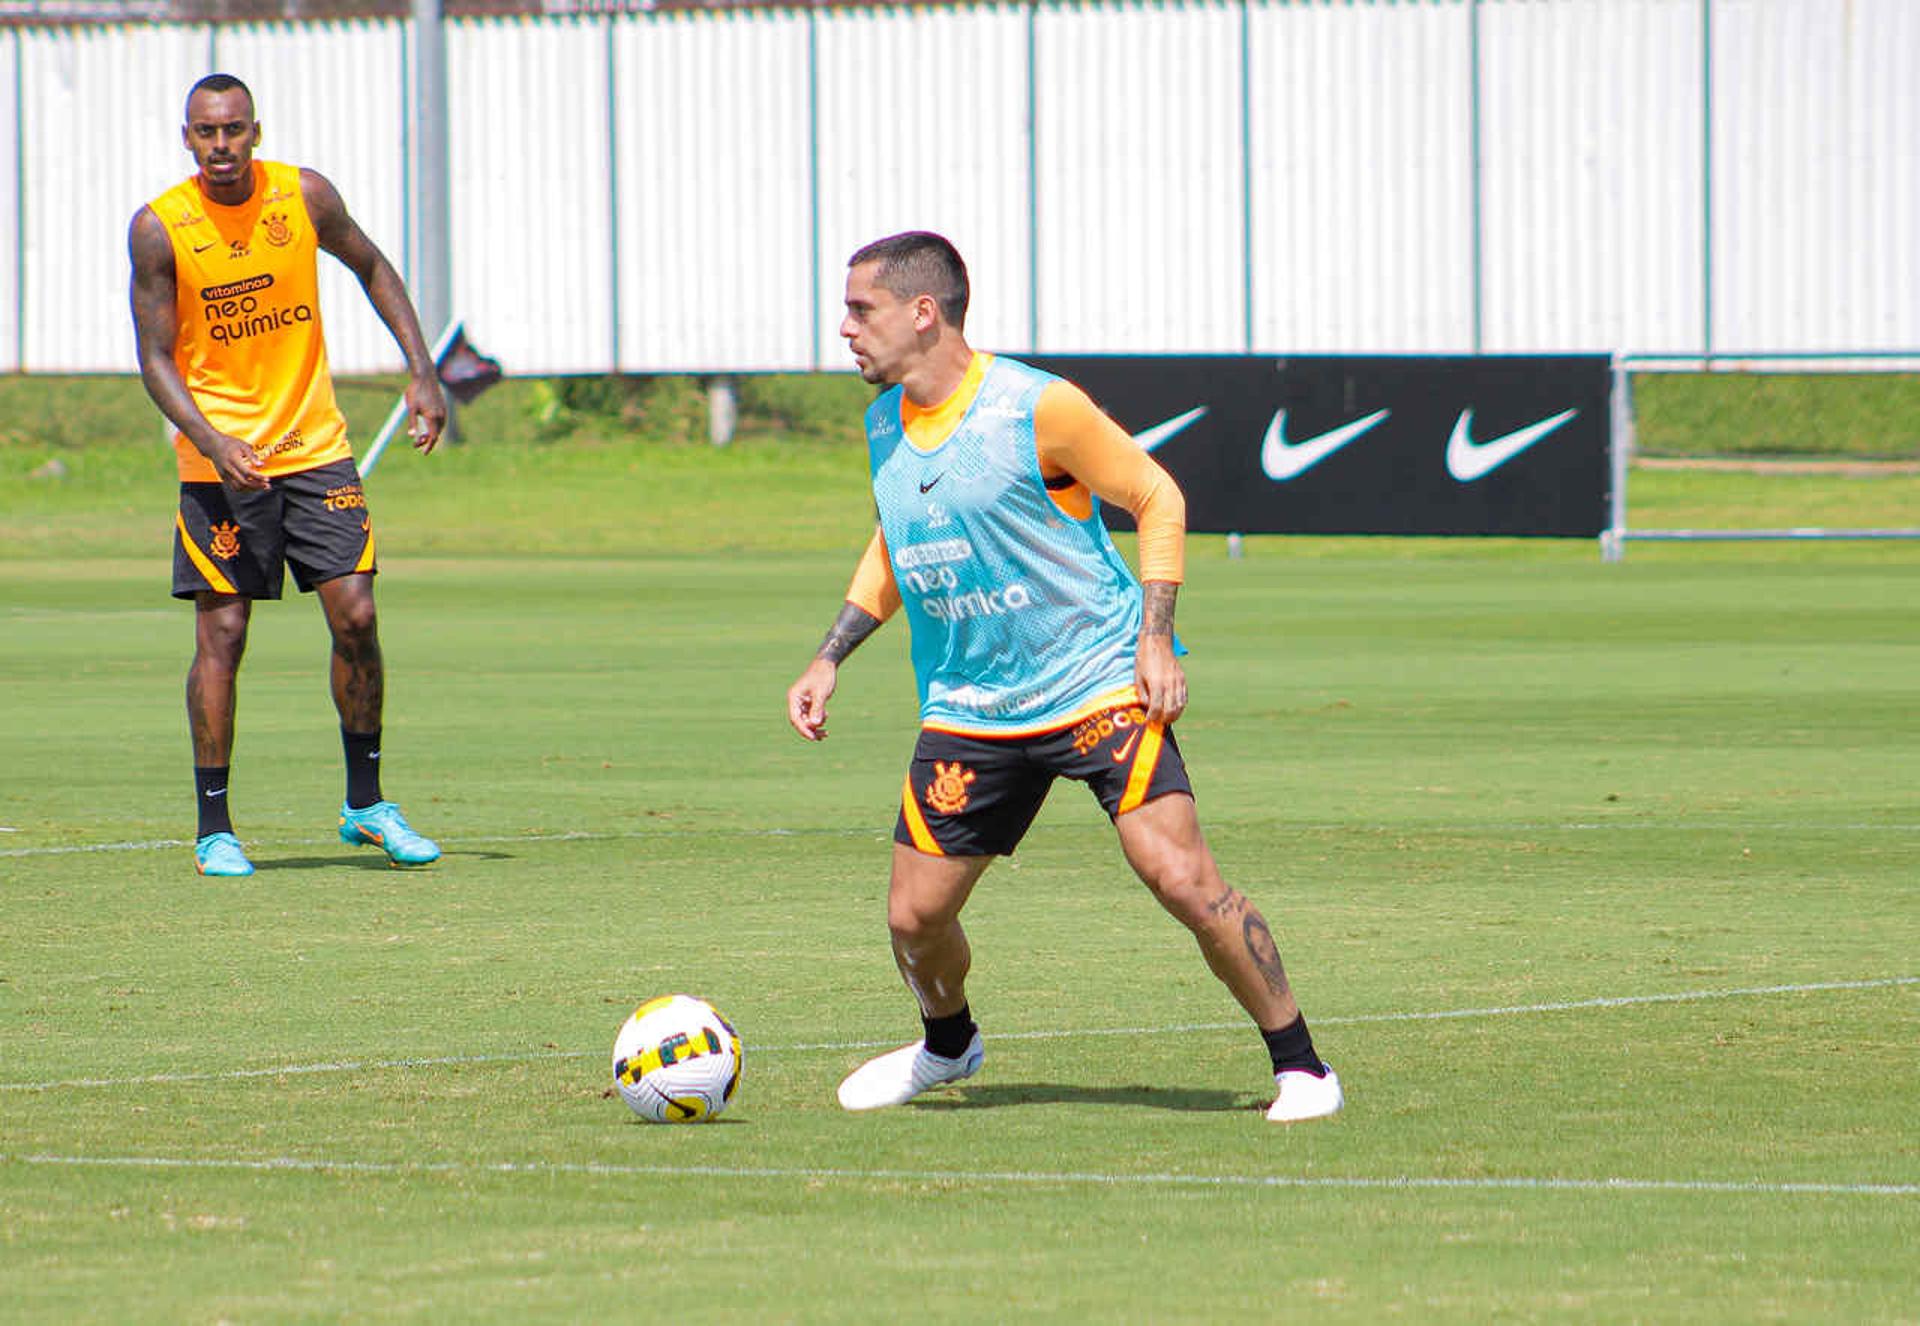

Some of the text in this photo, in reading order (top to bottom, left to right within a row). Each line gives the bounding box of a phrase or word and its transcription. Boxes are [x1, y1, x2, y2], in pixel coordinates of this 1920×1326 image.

[204, 296, 258, 321] neo
[210, 304, 312, 346] química
[905, 566, 958, 594] neo
[1073, 707, 1147, 756] TODOS
